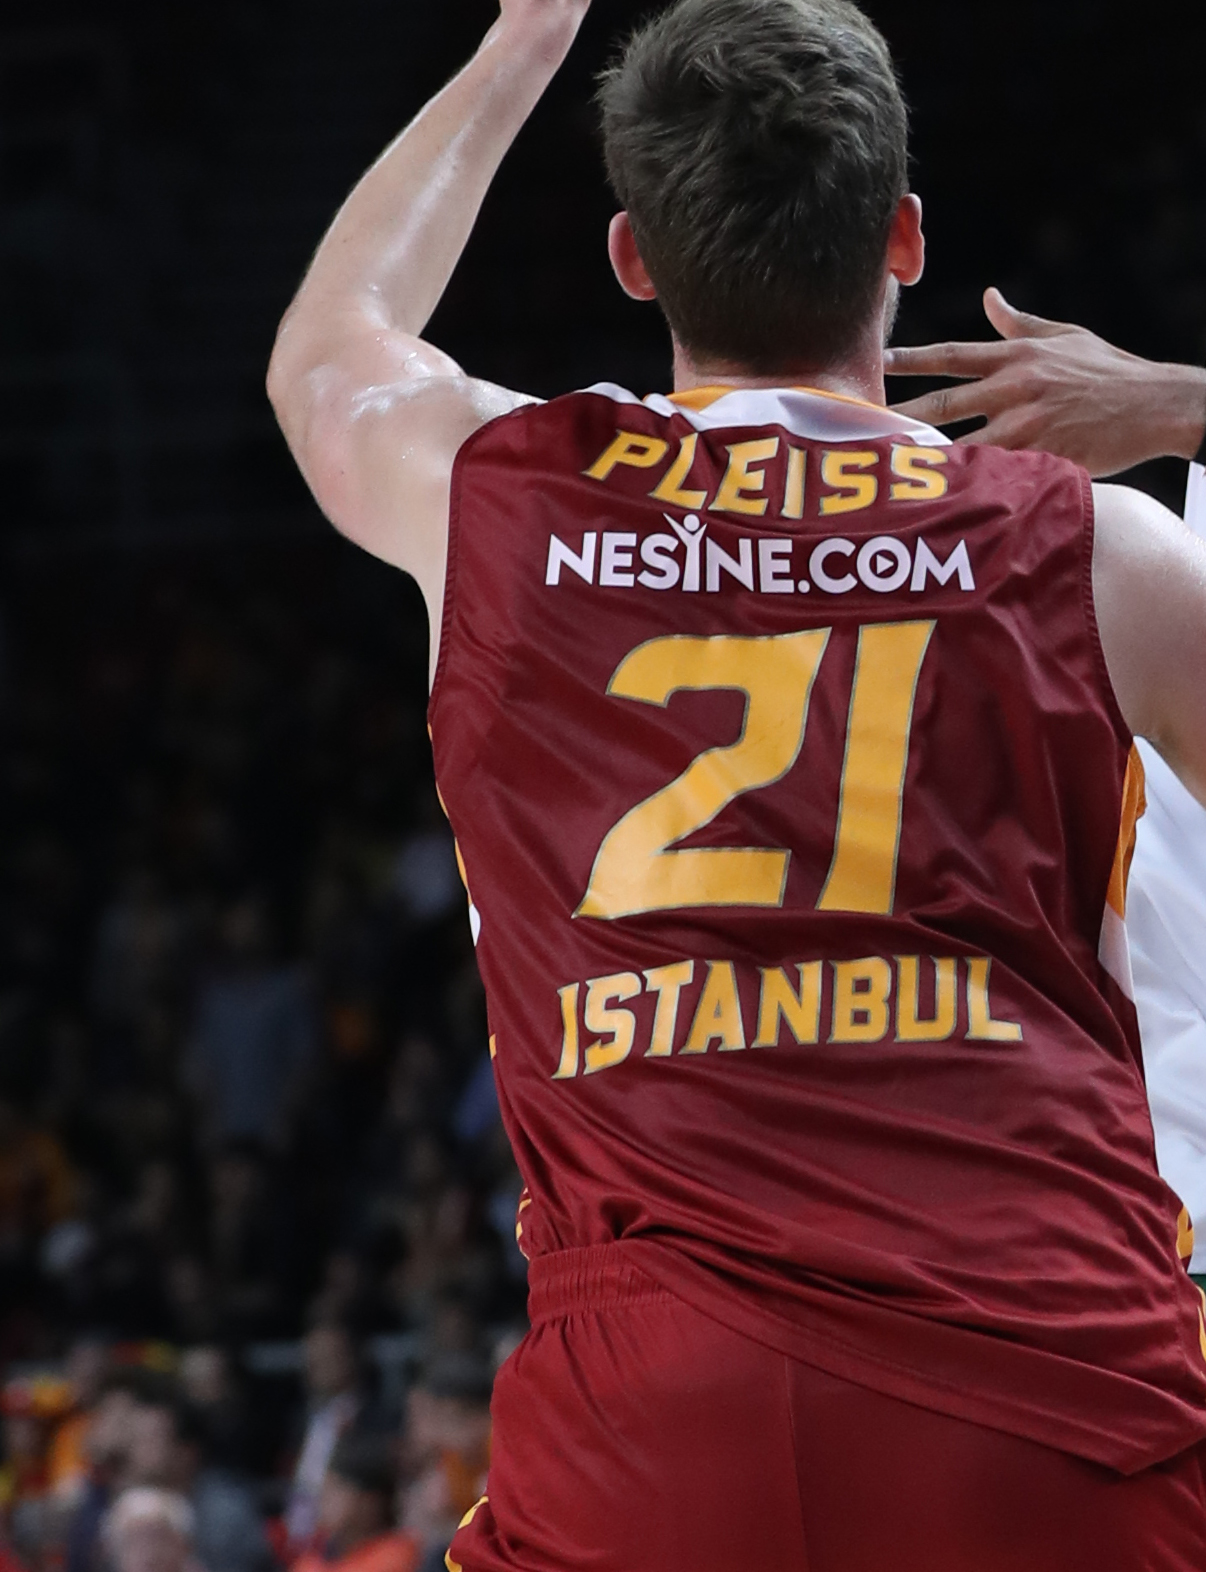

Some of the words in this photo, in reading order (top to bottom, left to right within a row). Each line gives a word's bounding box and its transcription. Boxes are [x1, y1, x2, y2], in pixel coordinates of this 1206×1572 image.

[582, 429, 949, 519] PLEISS
[545, 511, 976, 594] NESINE.COM
[571, 618, 938, 920] 21
[551, 954, 1023, 1080] ISTANBUL
